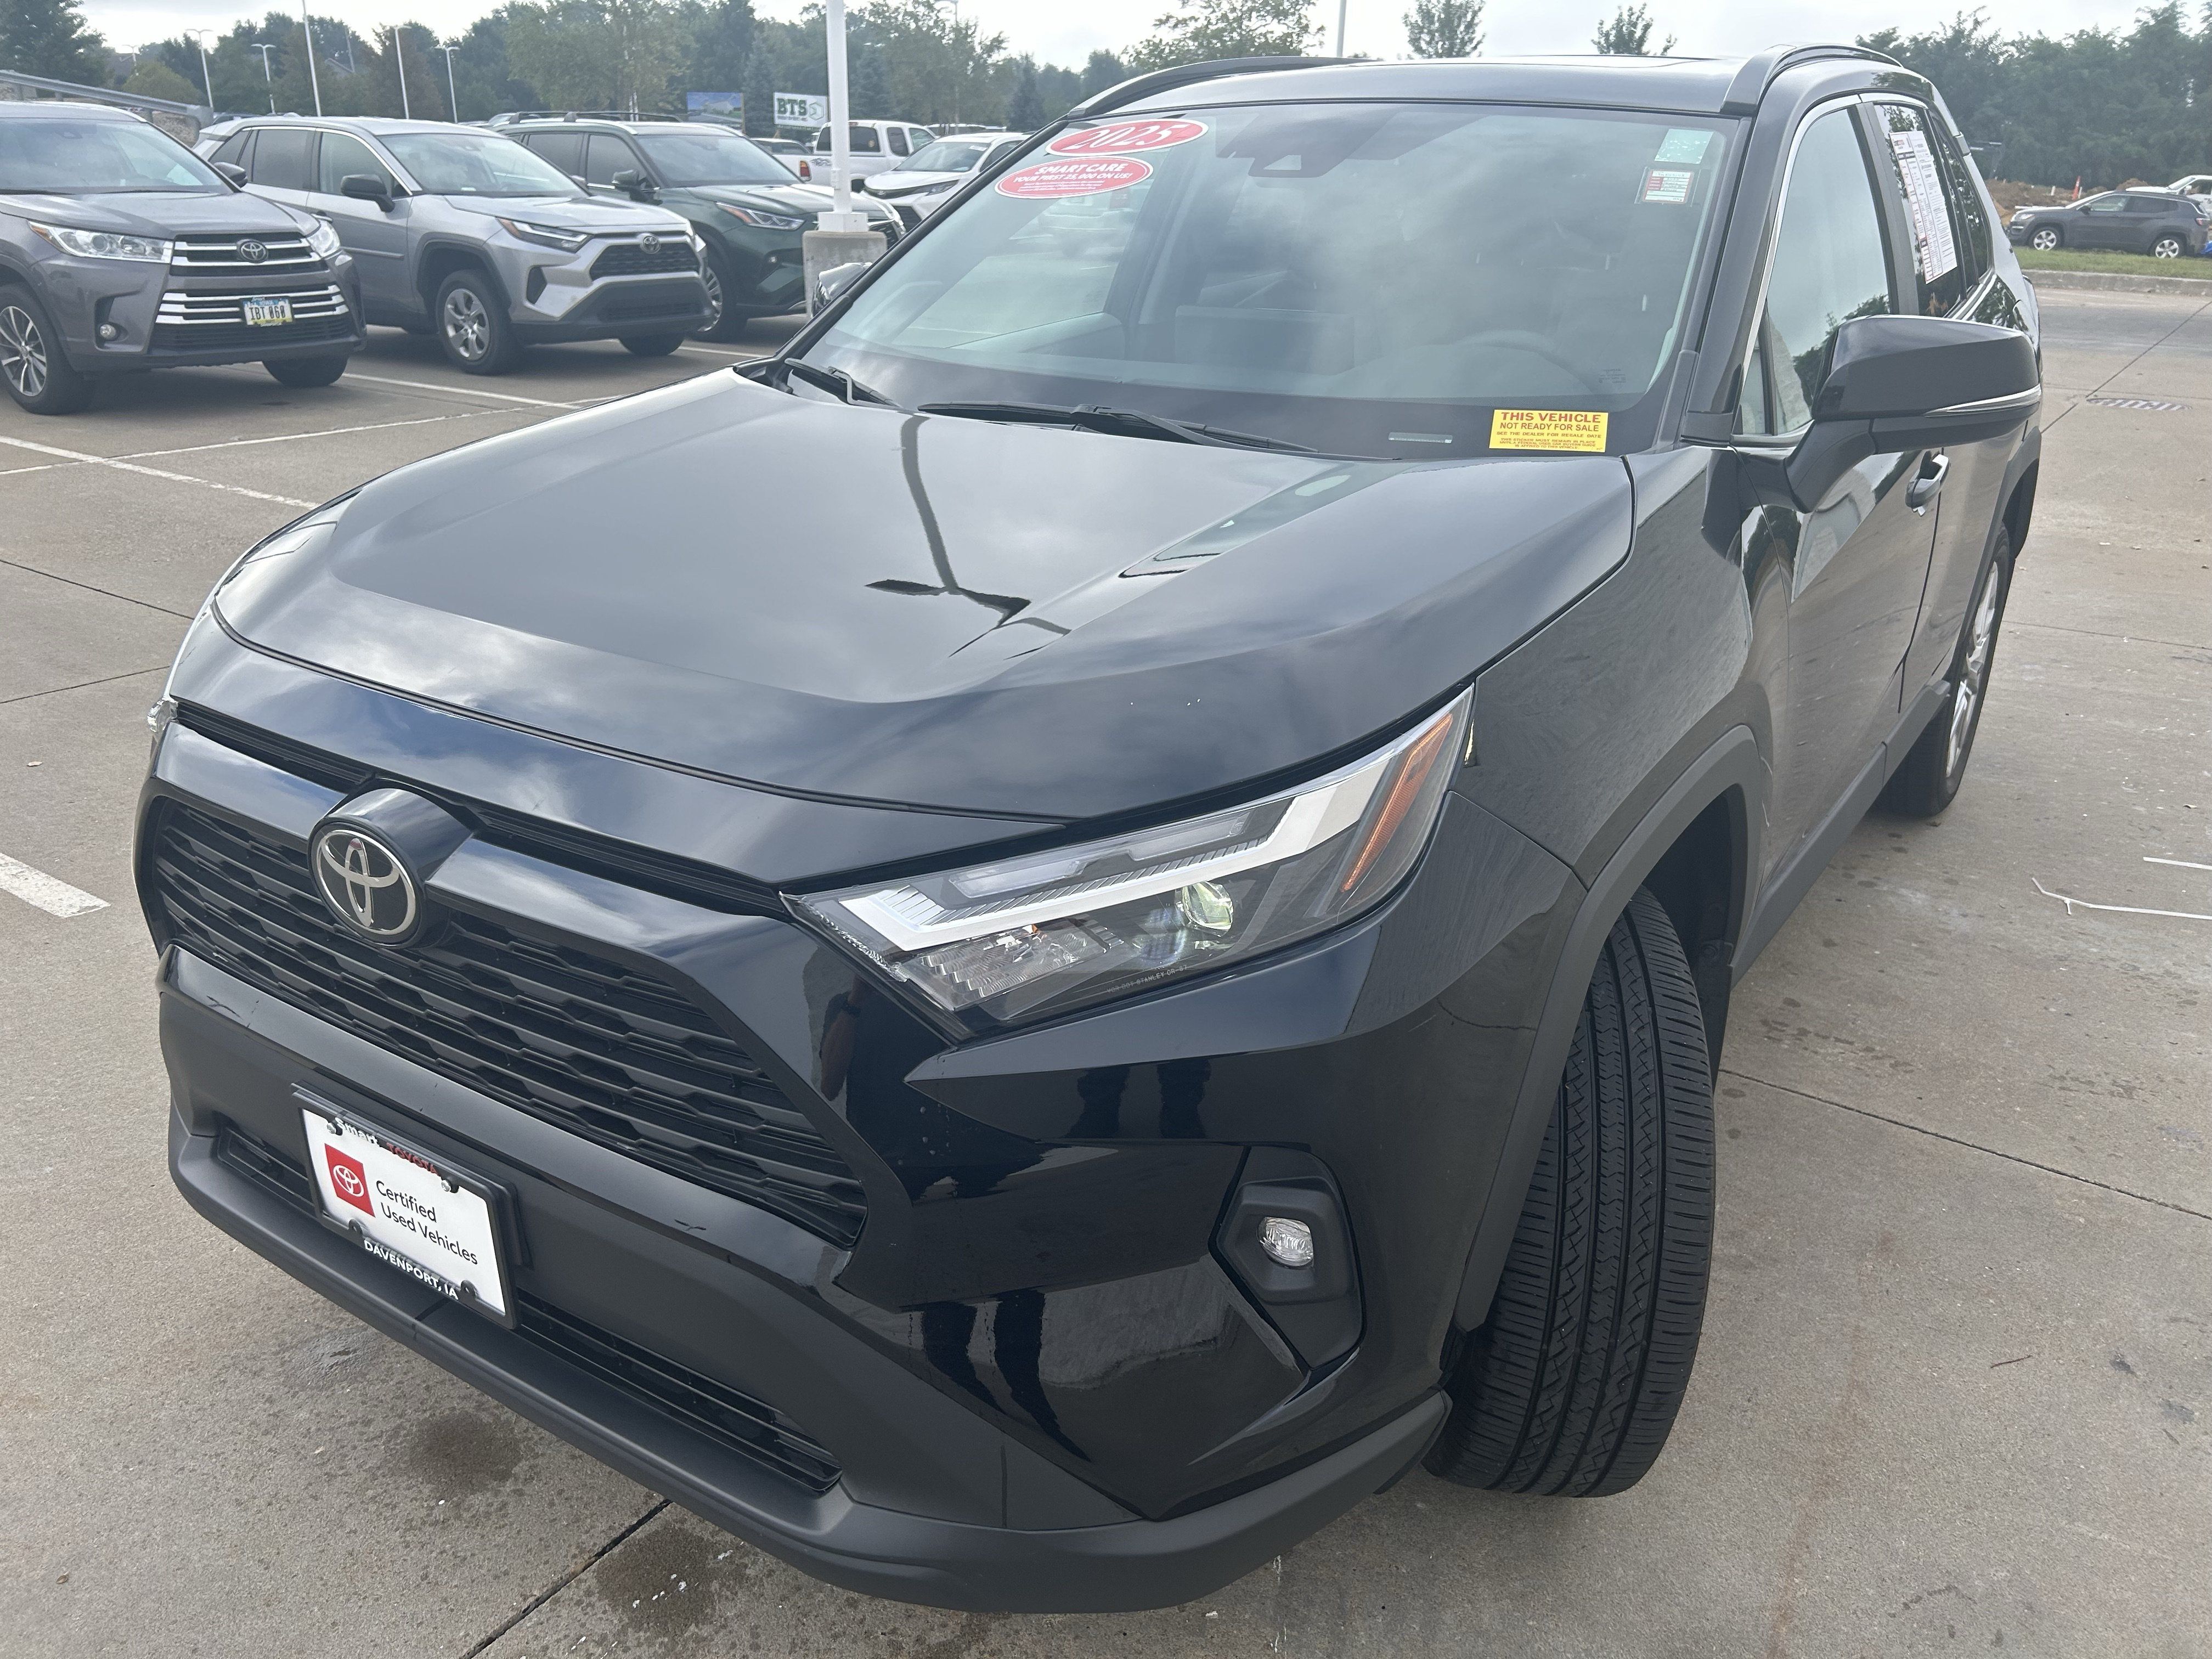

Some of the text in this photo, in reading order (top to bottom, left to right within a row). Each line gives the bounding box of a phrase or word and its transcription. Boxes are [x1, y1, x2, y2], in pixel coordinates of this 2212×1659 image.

[777, 98, 807, 116] BTS
[1060, 124, 1191, 150] 2025
[1036, 163, 1129, 175] SMART CARE
[249, 307, 266, 320] IBT
[1501, 412, 1601, 423] THIS VEHICLE
[1136, 971, 1166, 985] STANLEY
[335, 1117, 438, 1174] Smart TOYOTA
[376, 1180, 437, 1223] Certified
[381, 1201, 478, 1265] Used Vehicles
[364, 1239, 459, 1300] DAVENPORT, IA
